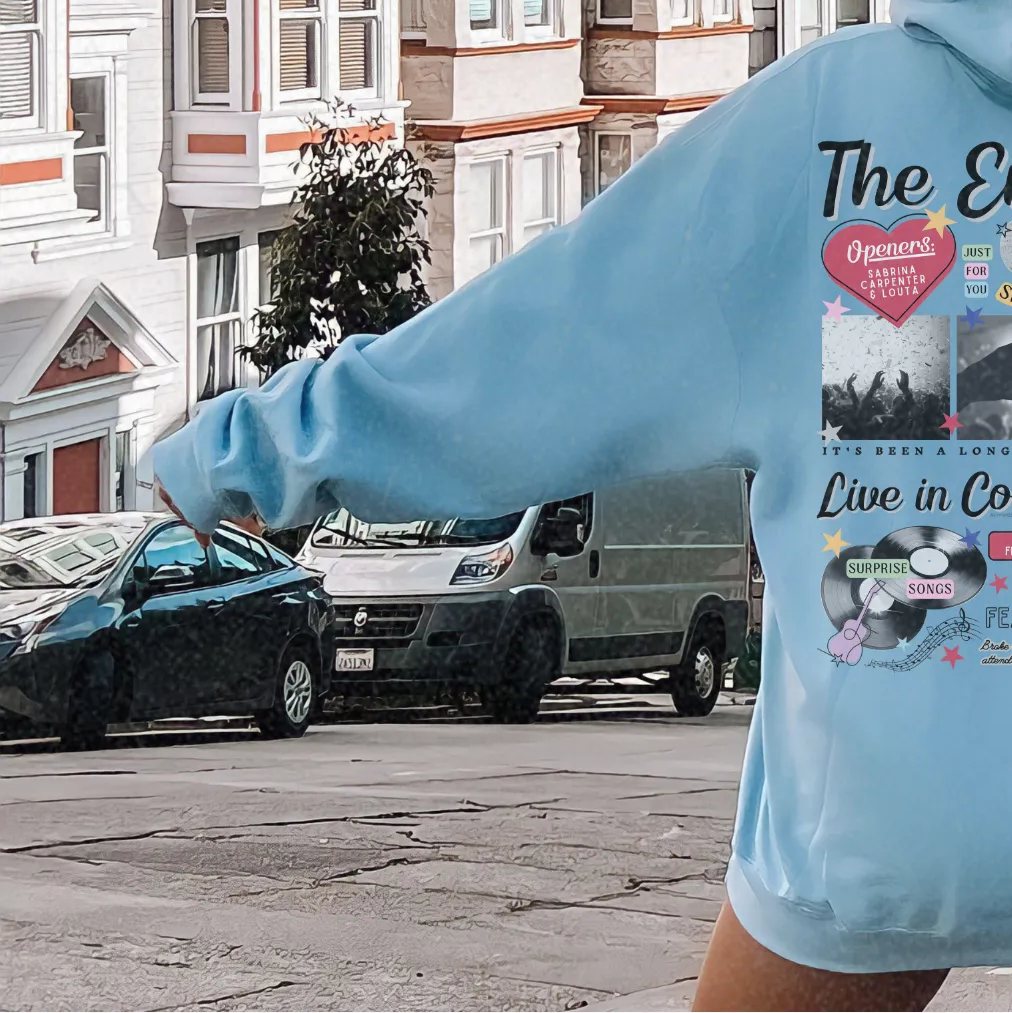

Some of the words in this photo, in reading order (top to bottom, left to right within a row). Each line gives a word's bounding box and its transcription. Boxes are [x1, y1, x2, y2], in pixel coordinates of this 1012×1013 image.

[818, 139, 937, 220] The
[846, 236, 935, 267] Openers:
[963, 247, 992, 258] JUST
[868, 265, 916, 279] SABRINA
[966, 266, 987, 276] FOR
[860, 274, 926, 290] CARPENTER
[869, 289, 876, 300] &
[882, 286, 919, 298] LOUTA
[966, 284, 987, 295] YOU
[822, 446, 863, 456] IT'S
[875, 446, 924, 456] BEEN
[936, 446, 947, 456] A
[959, 446, 1011, 456] LONG
[817, 471, 905, 520] Live
[915, 478, 954, 513] in
[848, 562, 908, 574] SURPRISE
[908, 583, 952, 595] SONGS
[980, 639, 1010, 651] Broke
